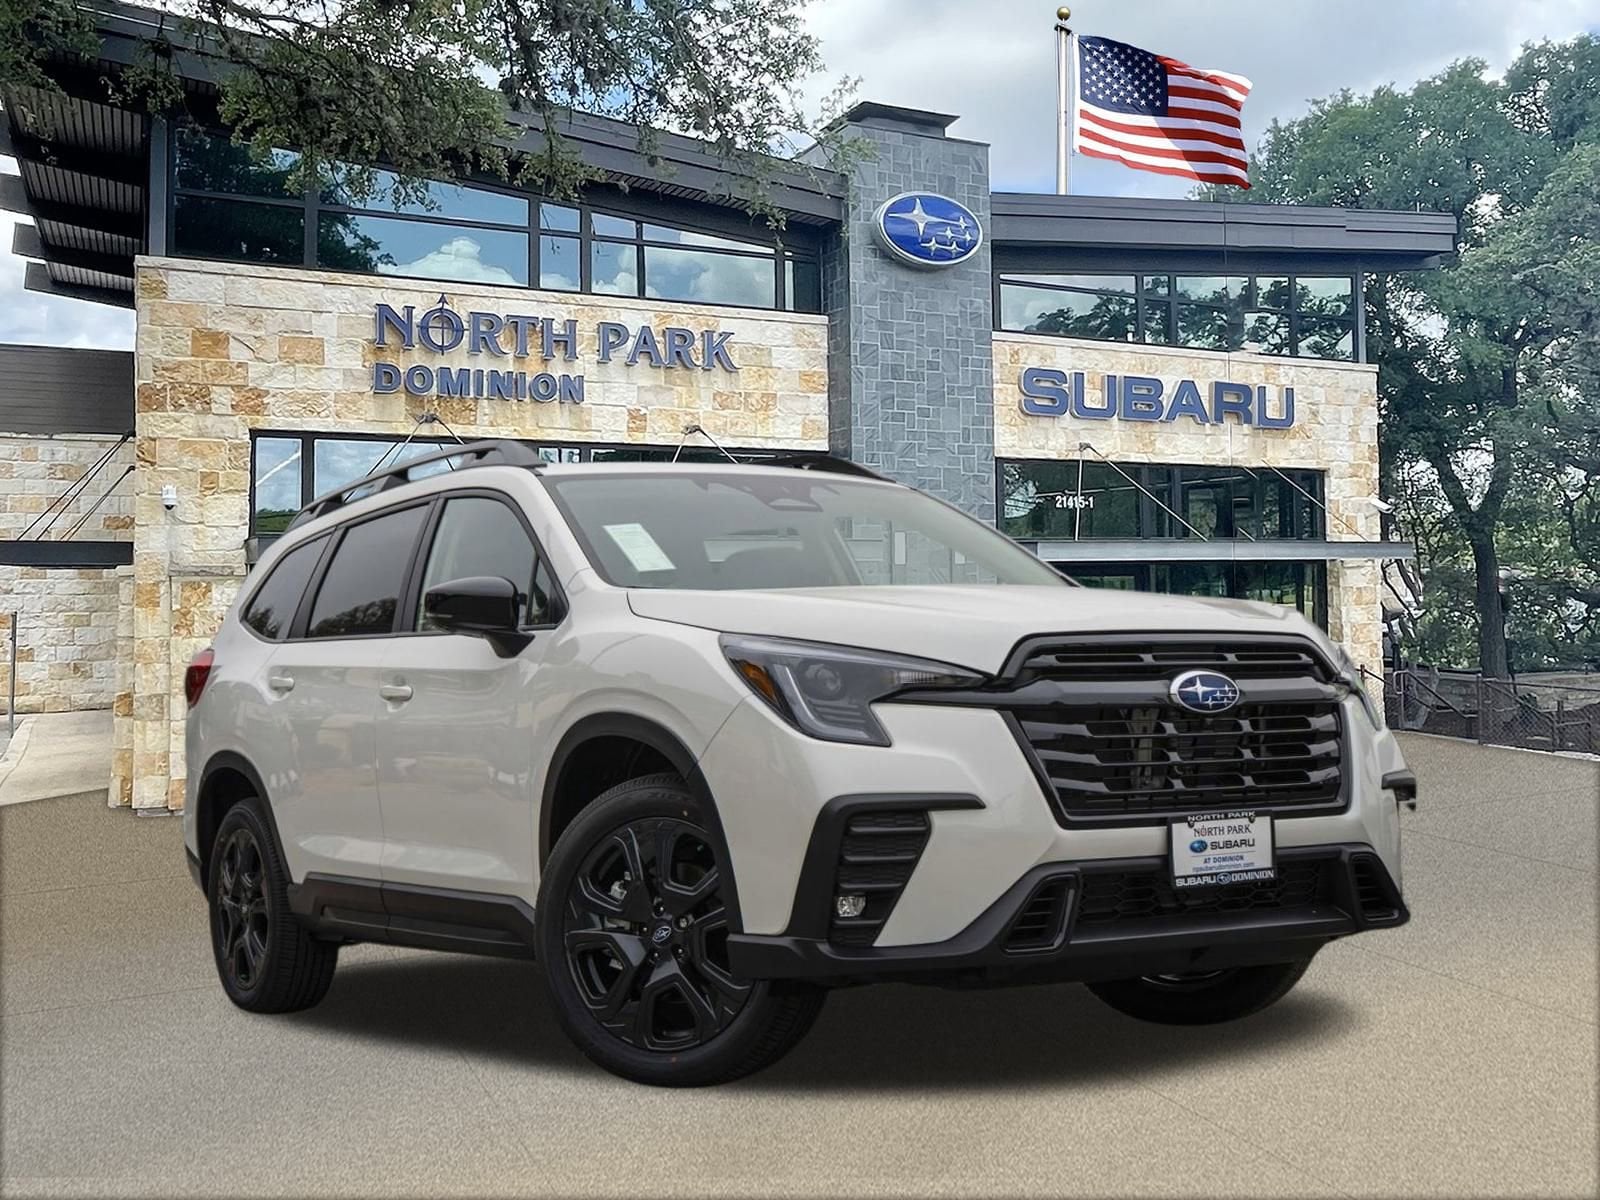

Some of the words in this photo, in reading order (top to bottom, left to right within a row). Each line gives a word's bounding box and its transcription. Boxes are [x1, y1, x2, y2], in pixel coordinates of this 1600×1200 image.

[374, 292, 580, 362] NORTH
[597, 320, 742, 374] PARK
[373, 362, 586, 404] DOMINION
[1019, 367, 1295, 430] SUBARU
[1055, 495, 1094, 509] 21415-1
[1193, 825, 1225, 837] NORTH
[1227, 824, 1252, 835] PARK
[1210, 838, 1255, 850] SUBARU
[1213, 855, 1244, 863] DOMINION
[1175, 875, 1217, 887] SUBARU
[1231, 870, 1275, 882] DOMINION
